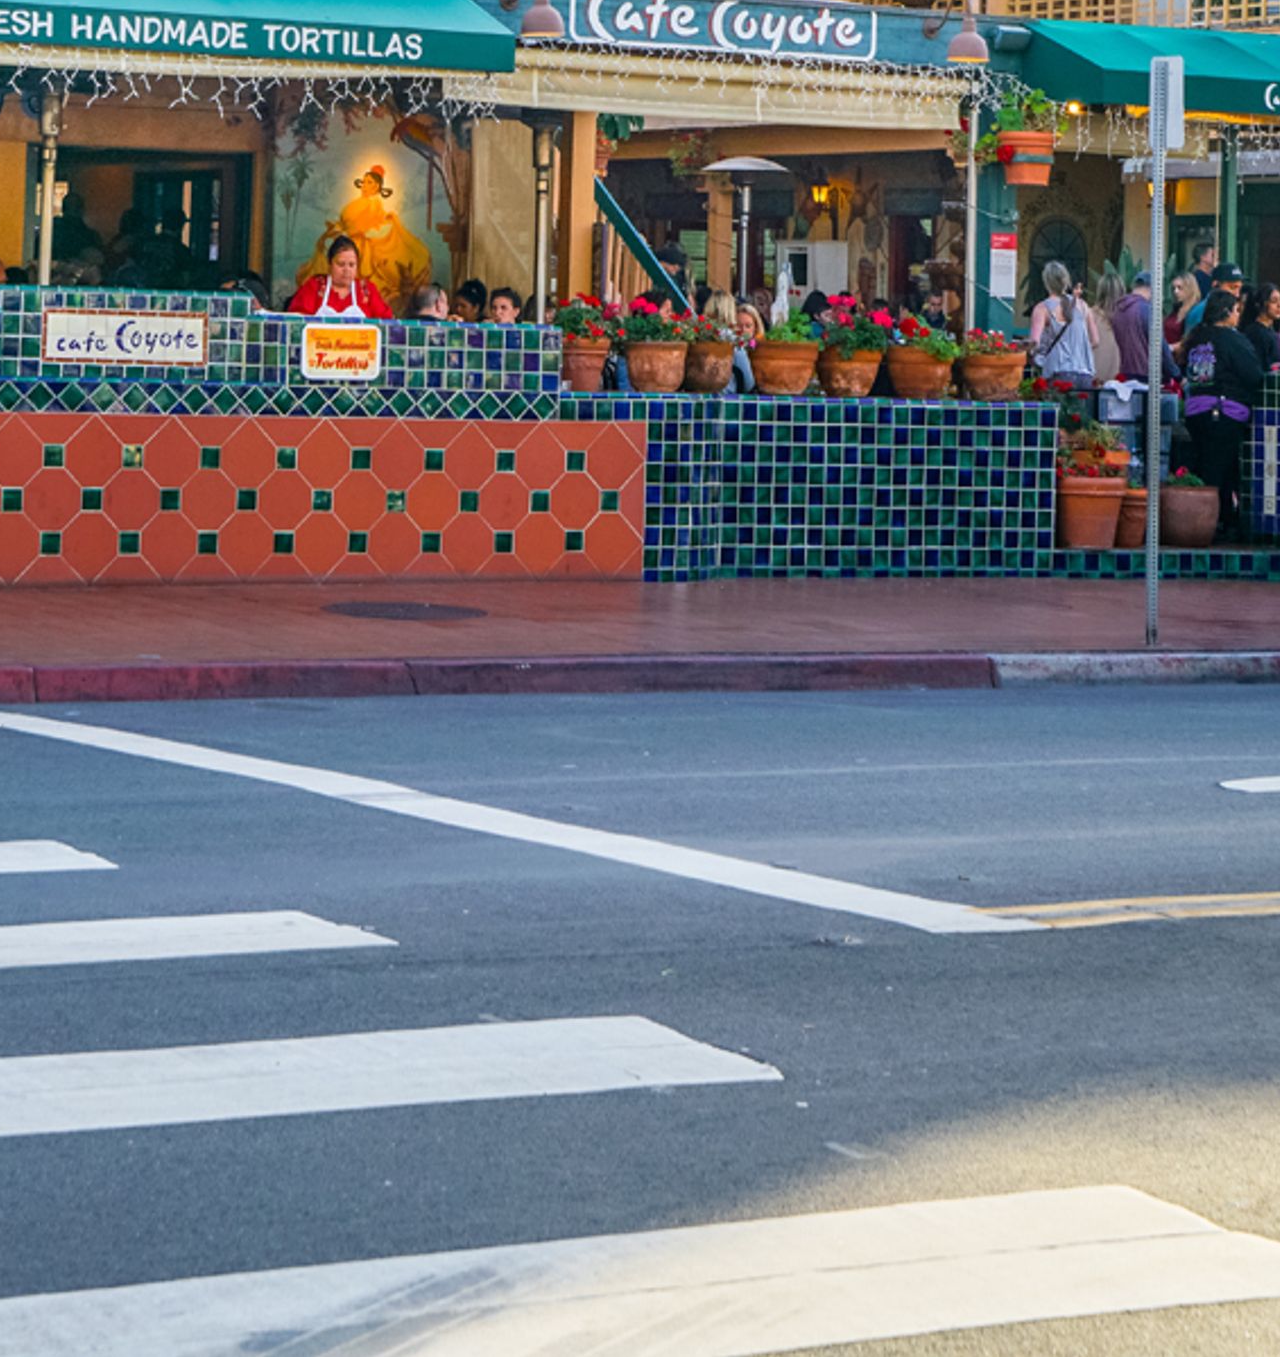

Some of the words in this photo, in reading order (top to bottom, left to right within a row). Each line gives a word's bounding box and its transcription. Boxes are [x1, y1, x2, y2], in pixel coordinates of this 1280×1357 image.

[70, 13, 249, 50] HANDMADE
[262, 24, 423, 61] TORTILLAS
[709, 0, 863, 55] Coyote
[56, 331, 108, 353] cafe
[114, 321, 199, 354] Coyote
[315, 352, 369, 370] Tortillas
